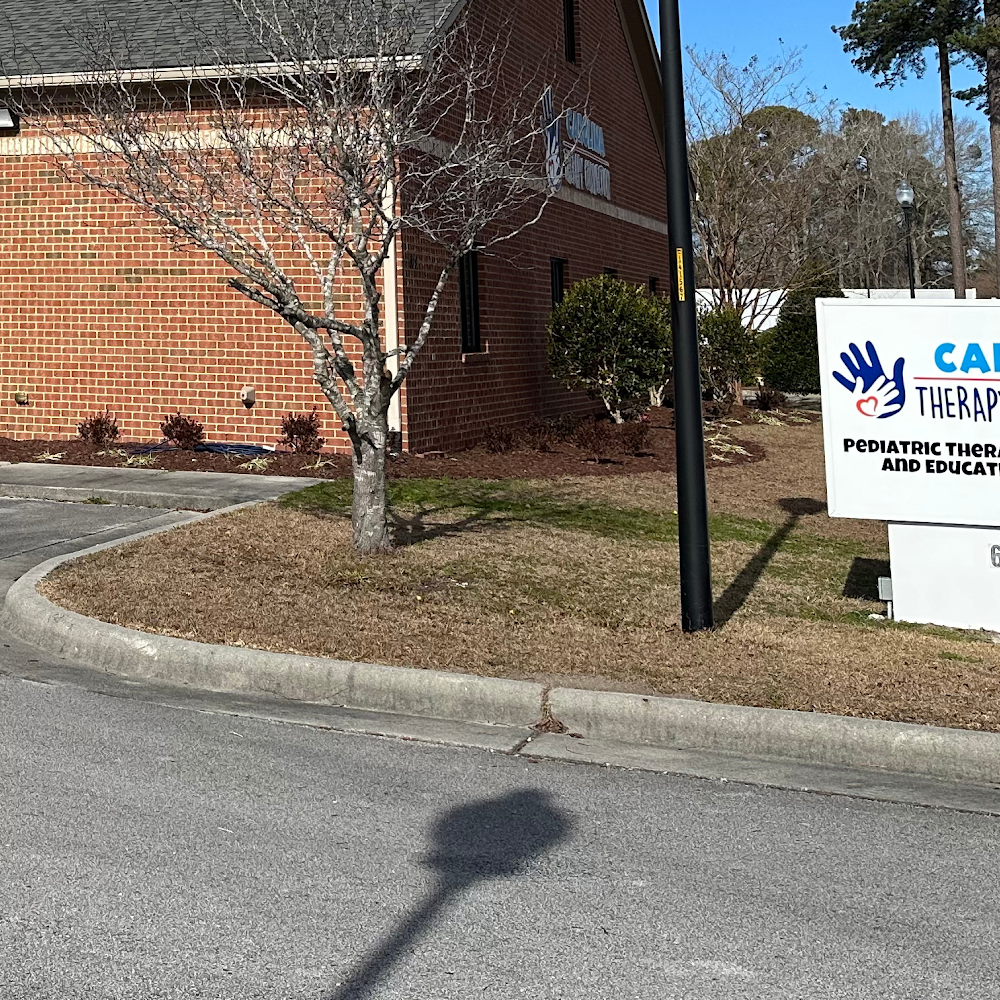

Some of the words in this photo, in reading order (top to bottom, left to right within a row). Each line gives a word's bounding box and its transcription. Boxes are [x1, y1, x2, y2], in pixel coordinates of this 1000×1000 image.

[915, 385, 1000, 423] THERAP
[945, 442, 1000, 458] THER
[925, 459, 1000, 476] EDUCAT
